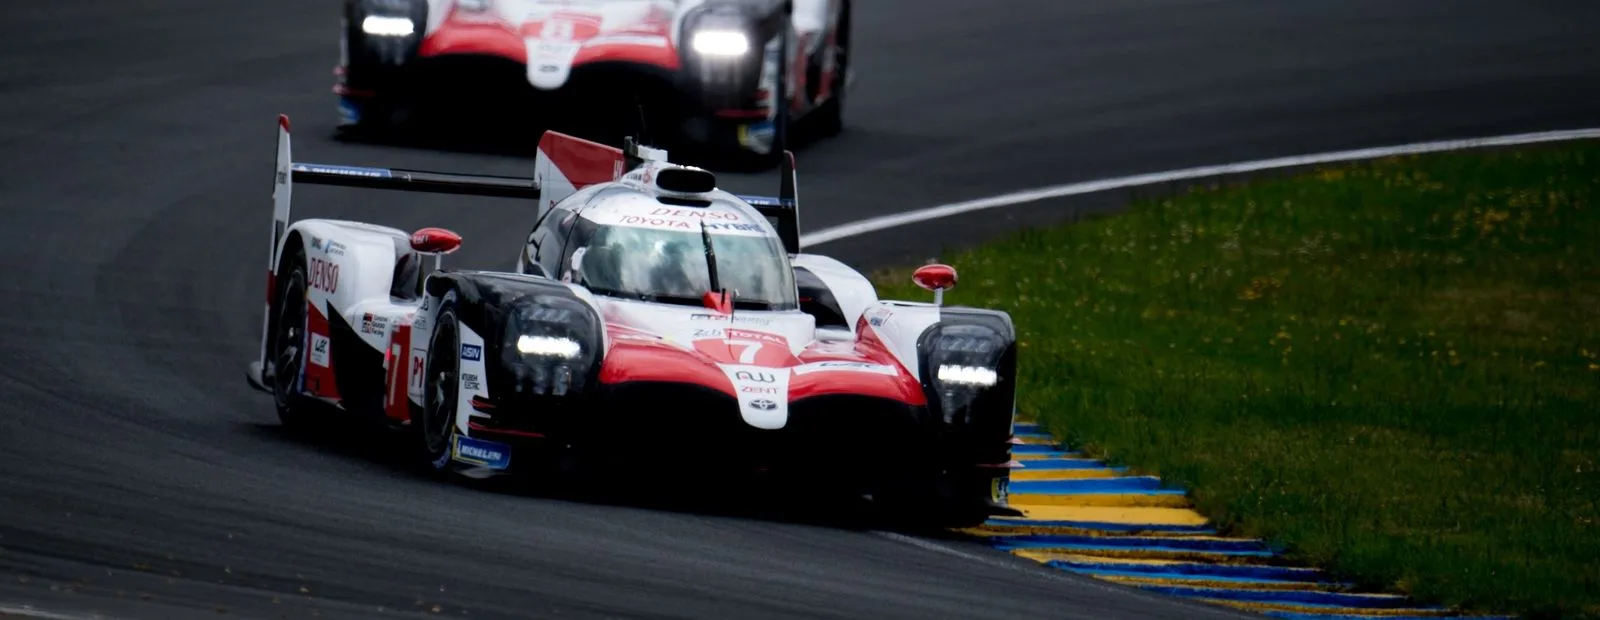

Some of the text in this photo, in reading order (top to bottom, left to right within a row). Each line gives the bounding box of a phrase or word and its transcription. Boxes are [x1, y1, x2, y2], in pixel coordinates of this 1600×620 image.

[649, 207, 739, 221] DENSO
[619, 215, 691, 229] TOYOTA
[308, 257, 339, 294] DENSO
[728, 330, 786, 345] TOTAL
[723, 339, 763, 364] 7
[413, 355, 424, 389] P1
[461, 445, 502, 460] MICHELIN
